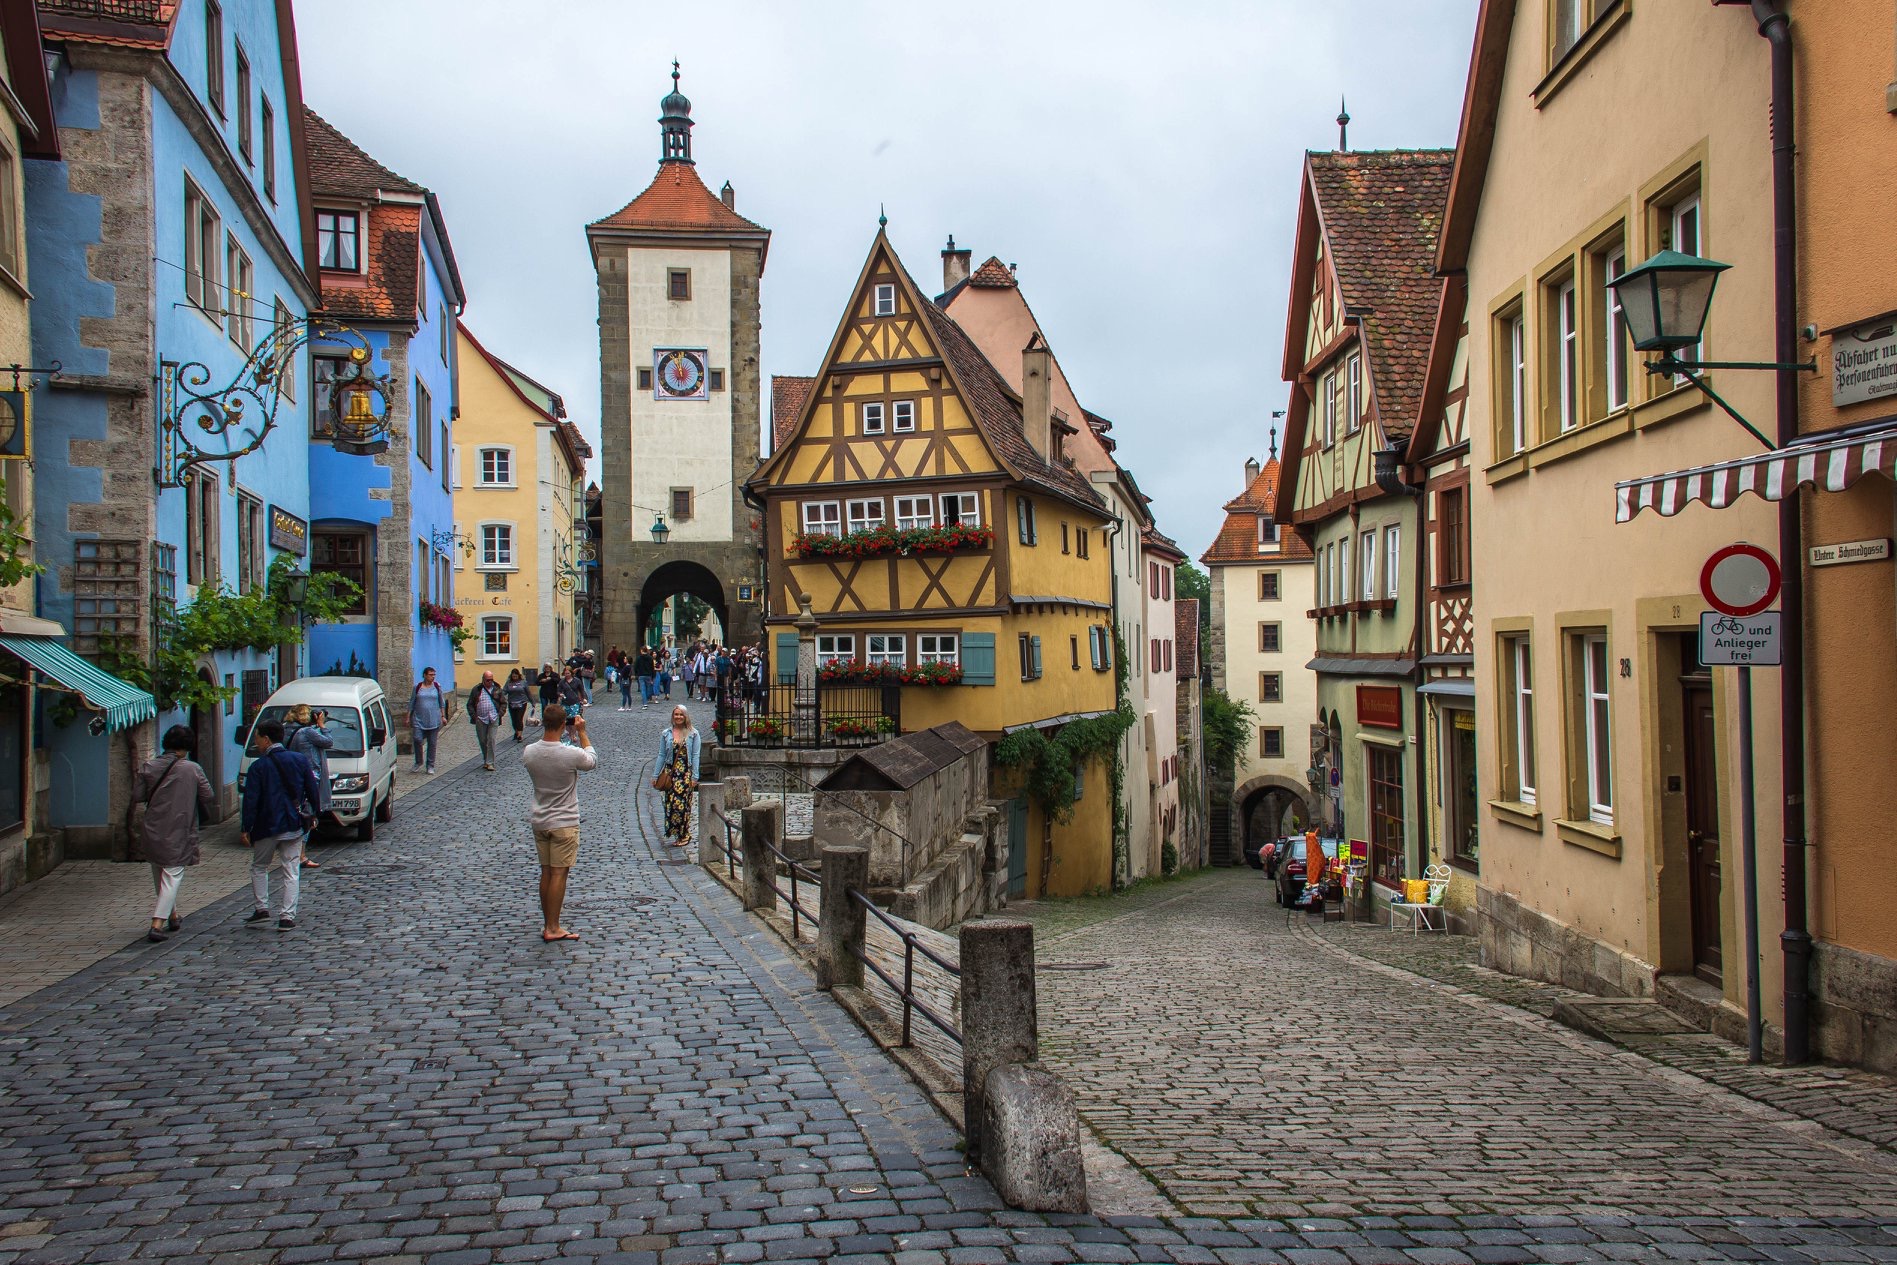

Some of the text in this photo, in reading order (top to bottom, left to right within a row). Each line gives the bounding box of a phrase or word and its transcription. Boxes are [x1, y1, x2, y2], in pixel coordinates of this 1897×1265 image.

[1835, 347, 1879, 373] Abfahrt
[1838, 544, 1883, 559] Schmiedgasse
[455, 597, 485, 606] äckerei
[1672, 605, 1681, 619] 28
[1749, 625, 1772, 635] und
[1714, 637, 1767, 651] Anlieger
[1730, 650, 1752, 660] frei
[344, 800, 360, 808] 798
